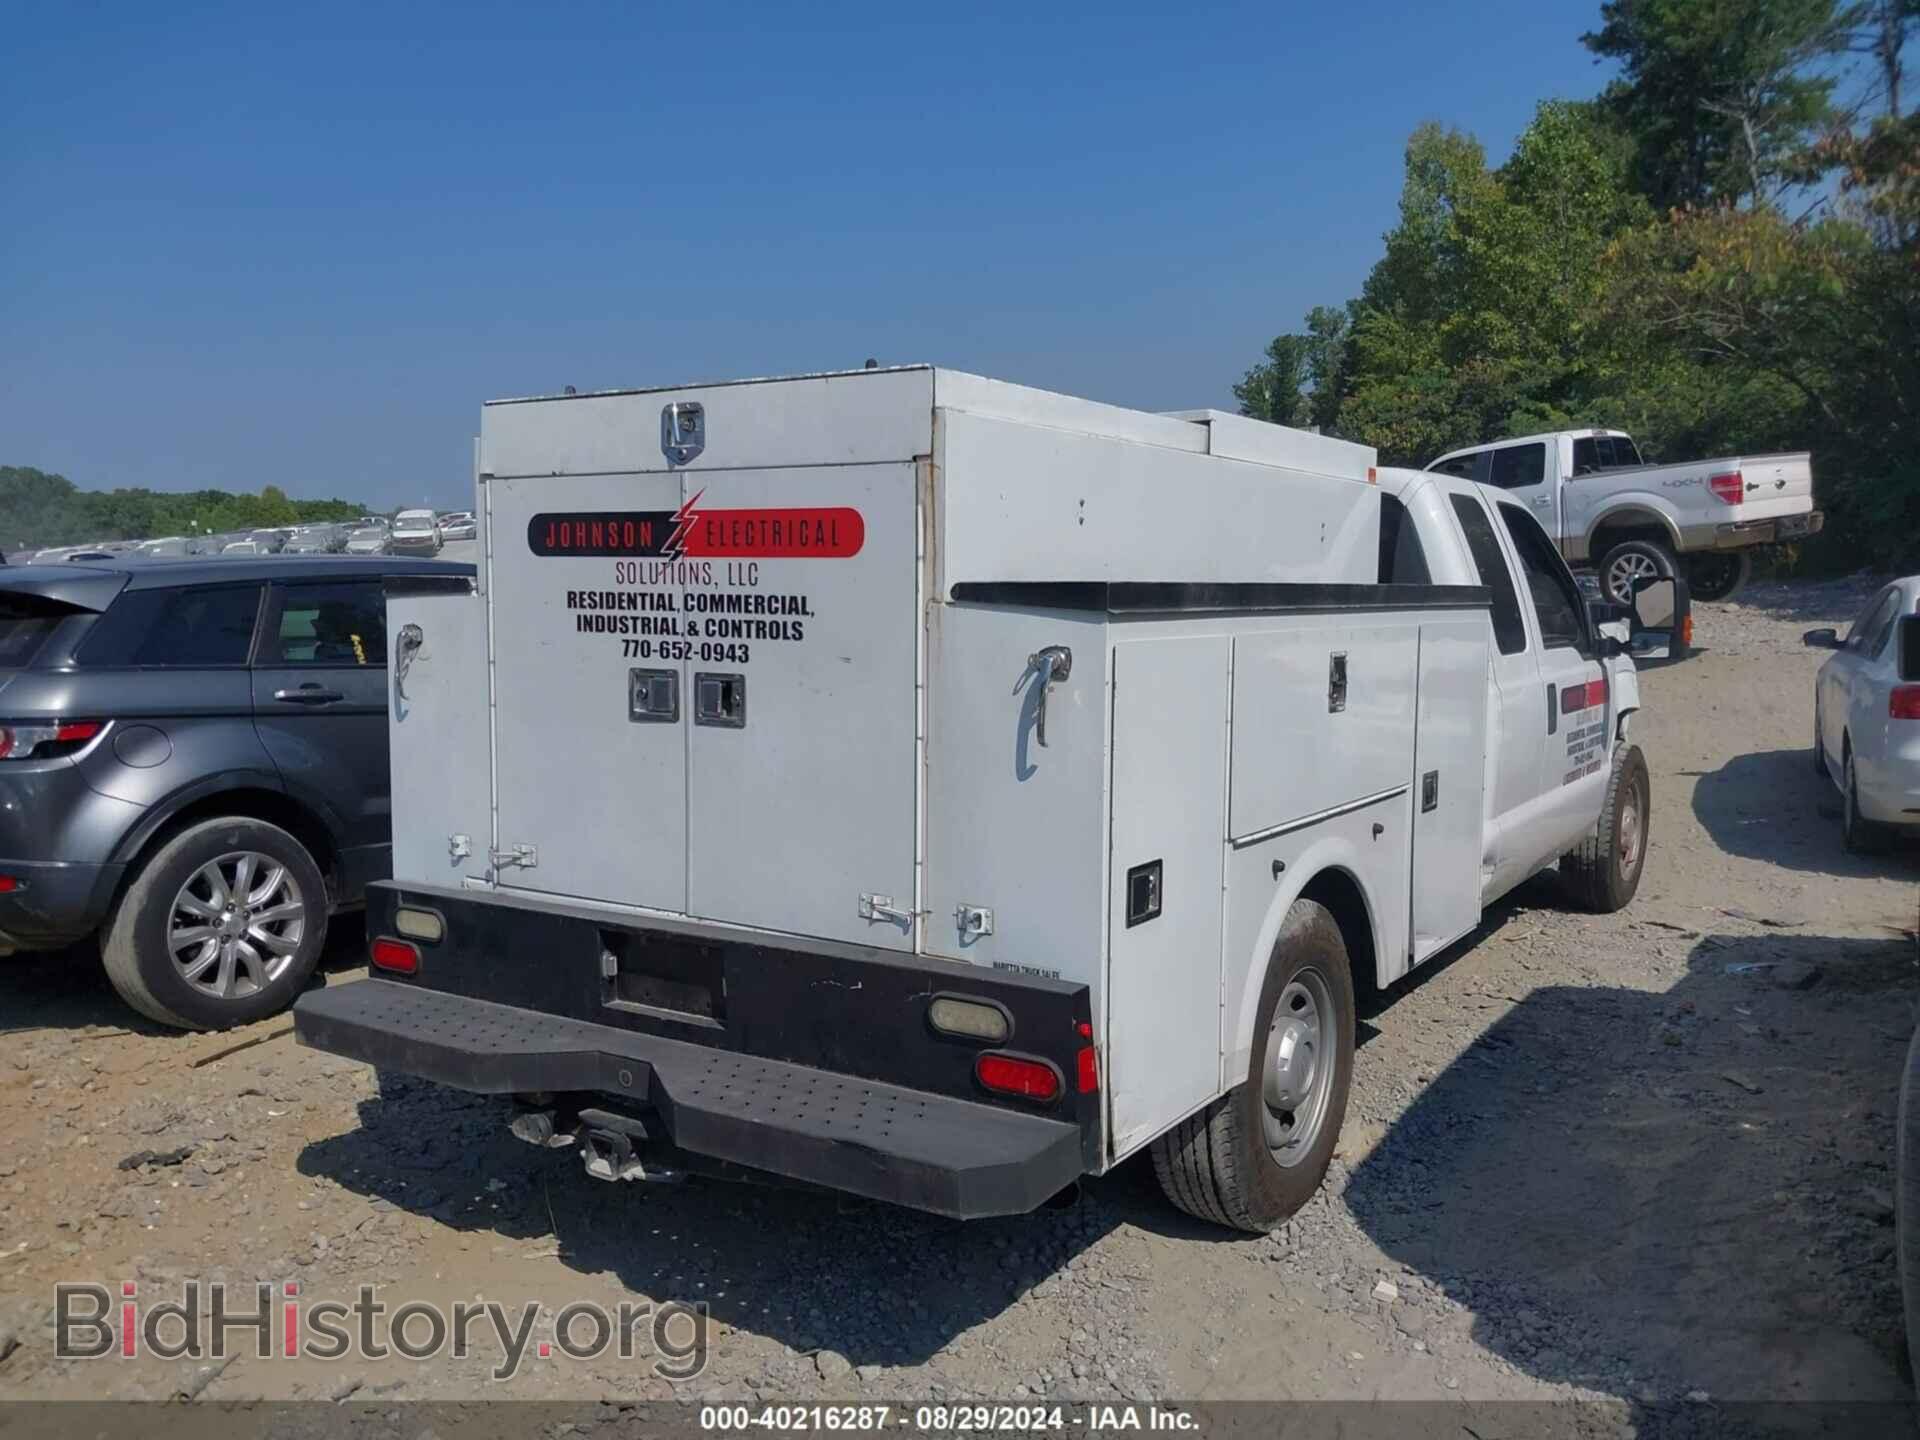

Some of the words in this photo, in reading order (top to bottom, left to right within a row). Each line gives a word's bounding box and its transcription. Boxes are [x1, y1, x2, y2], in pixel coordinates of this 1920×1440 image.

[545, 521, 653, 548] JOHNSON
[707, 519, 840, 547] ELECTRICAL
[616, 562, 719, 588] SOLUTIONS,
[728, 563, 759, 585] LLC
[567, 592, 681, 613] RESIDENTIAL,
[684, 595, 815, 617] COMMERCIAL,
[576, 615, 685, 637] INDUSTRIAL,
[687, 621, 700, 638] &
[704, 619, 804, 641] CONTROLS
[621, 639, 750, 663] 770-652-0943
[1021, 967, 1039, 976] TRUCK
